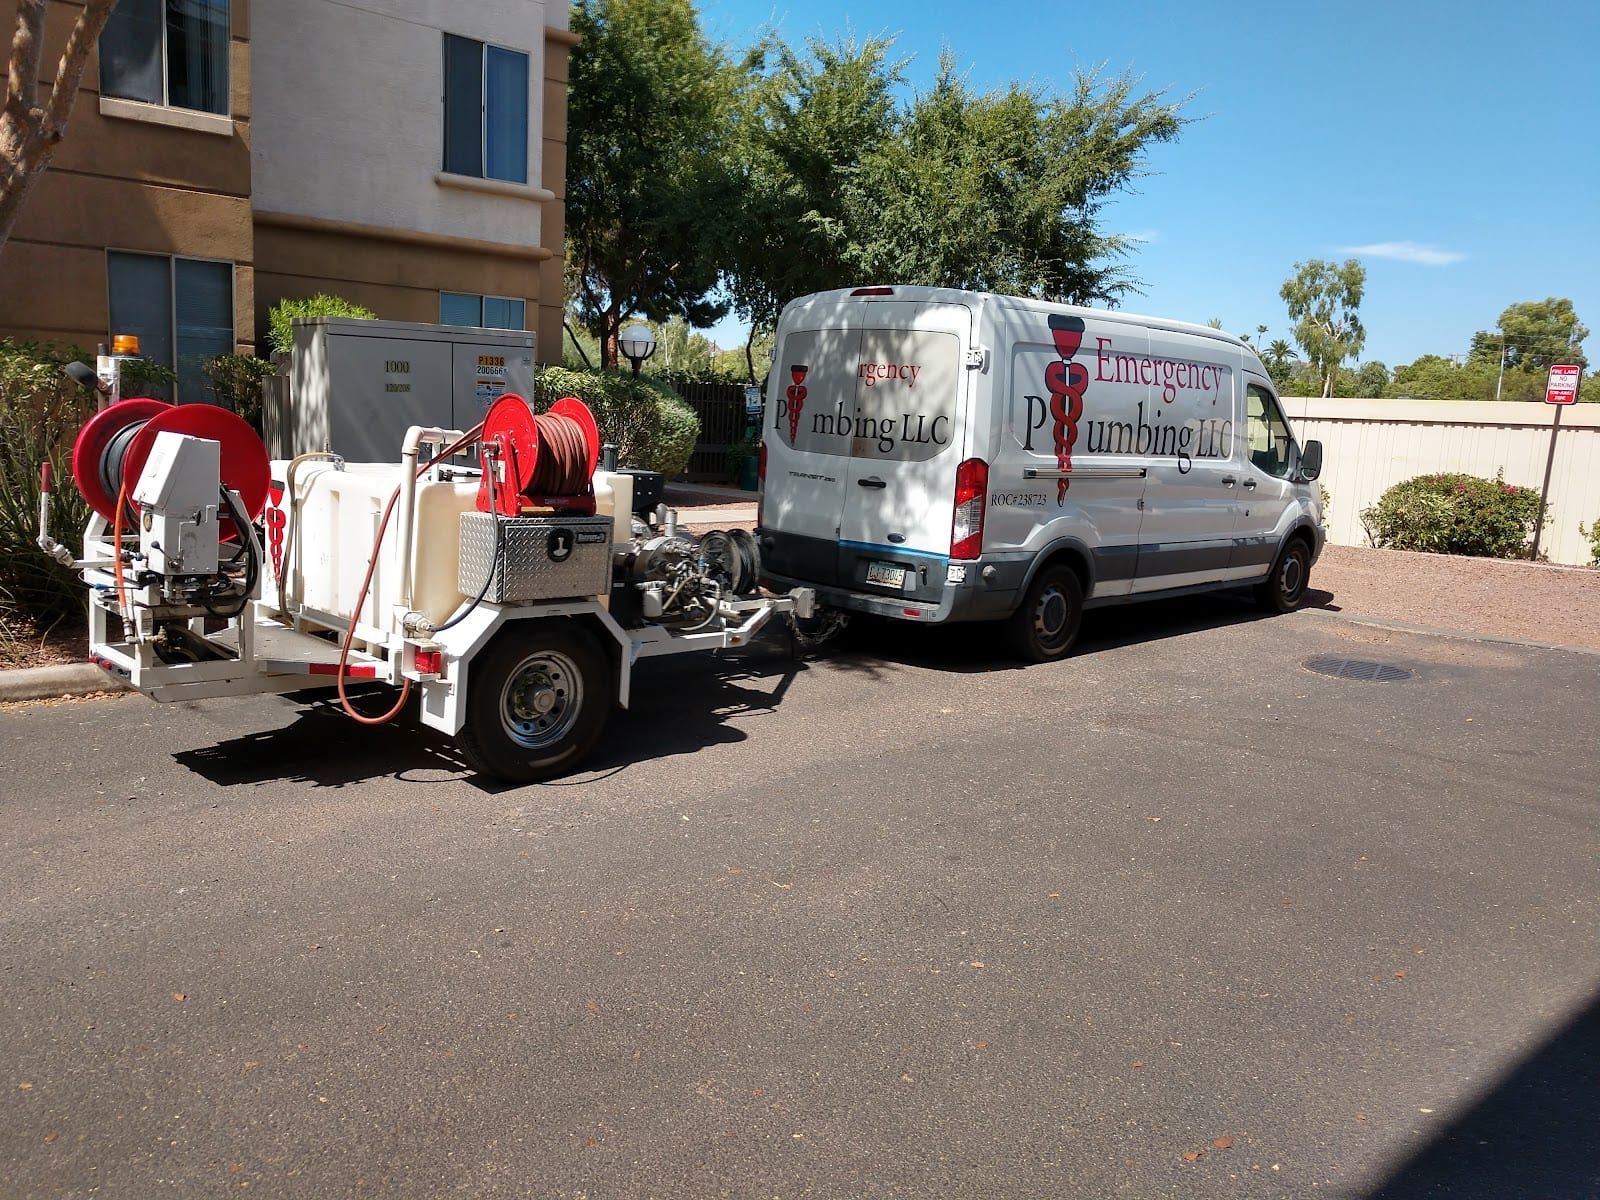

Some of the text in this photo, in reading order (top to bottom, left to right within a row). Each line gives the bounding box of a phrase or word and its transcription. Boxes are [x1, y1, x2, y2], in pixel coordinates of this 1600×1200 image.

[384, 360, 410, 373] 1000
[478, 356, 504, 366] P1336
[1094, 337, 1224, 405] Emergency
[858, 363, 921, 388] rgency
[901, 414, 949, 445] LLC
[1195, 419, 1233, 458] LLC
[990, 493, 1047, 506] ROC#238723
